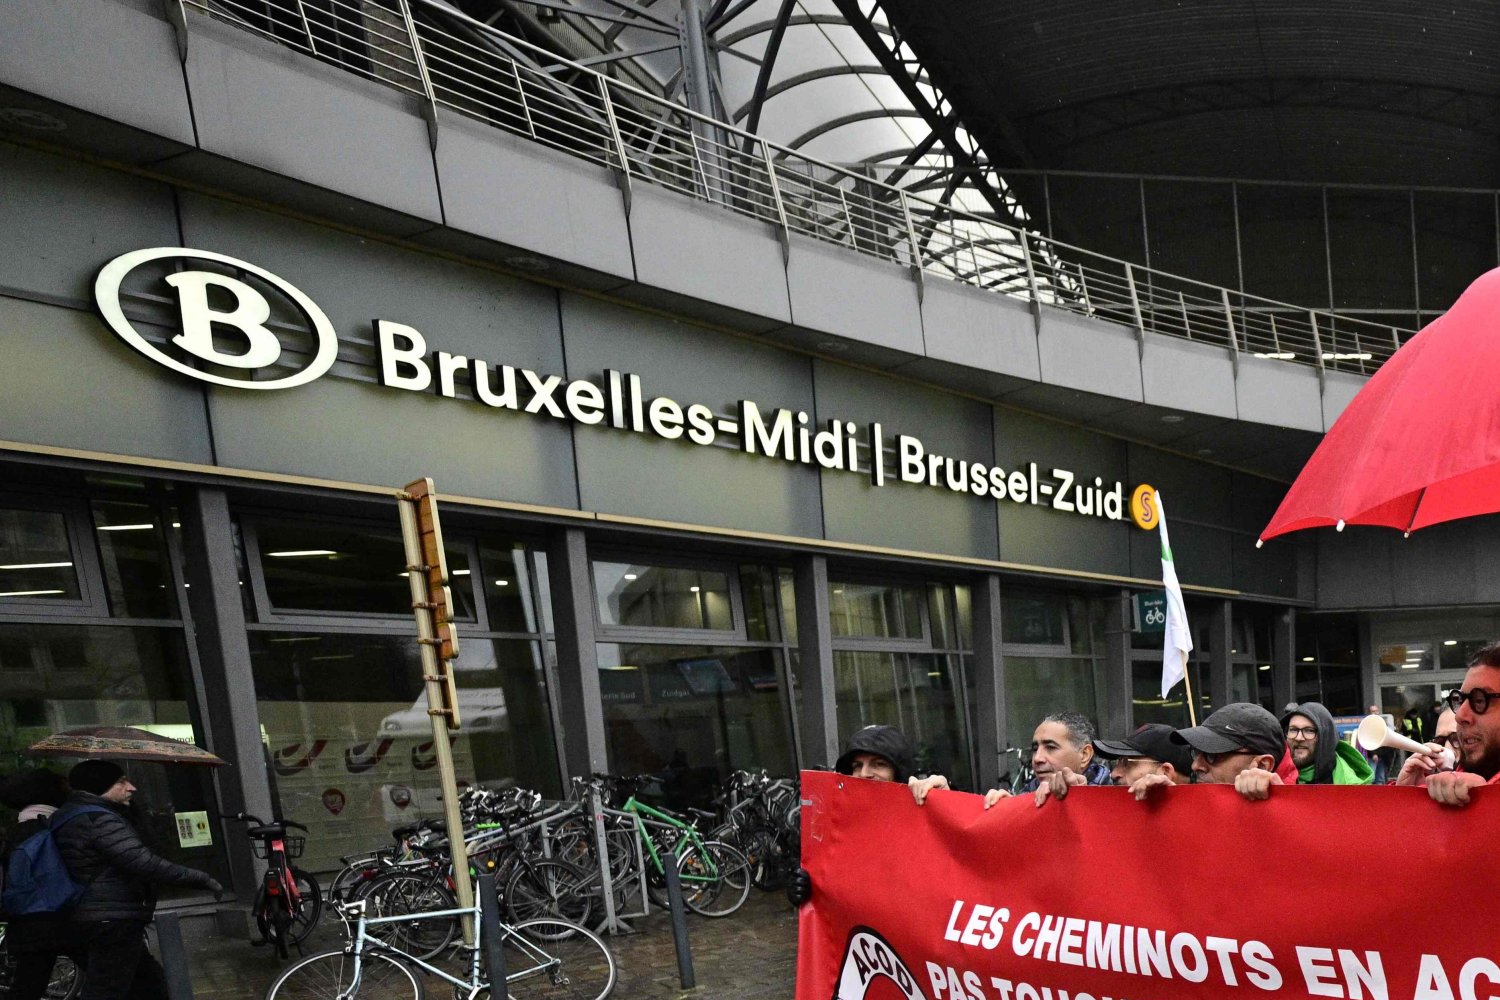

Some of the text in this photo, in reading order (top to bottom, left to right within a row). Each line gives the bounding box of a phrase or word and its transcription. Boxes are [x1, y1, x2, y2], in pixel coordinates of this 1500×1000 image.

[165, 271, 281, 368] B
[375, 319, 858, 472] Bruxelles-Midi
[898, 434, 1122, 520] Brussel-Zuid
[852, 937, 914, 996] ACOD
[944, 899, 1010, 950] LES
[1012, 911, 1283, 990] CHEMINOTS
